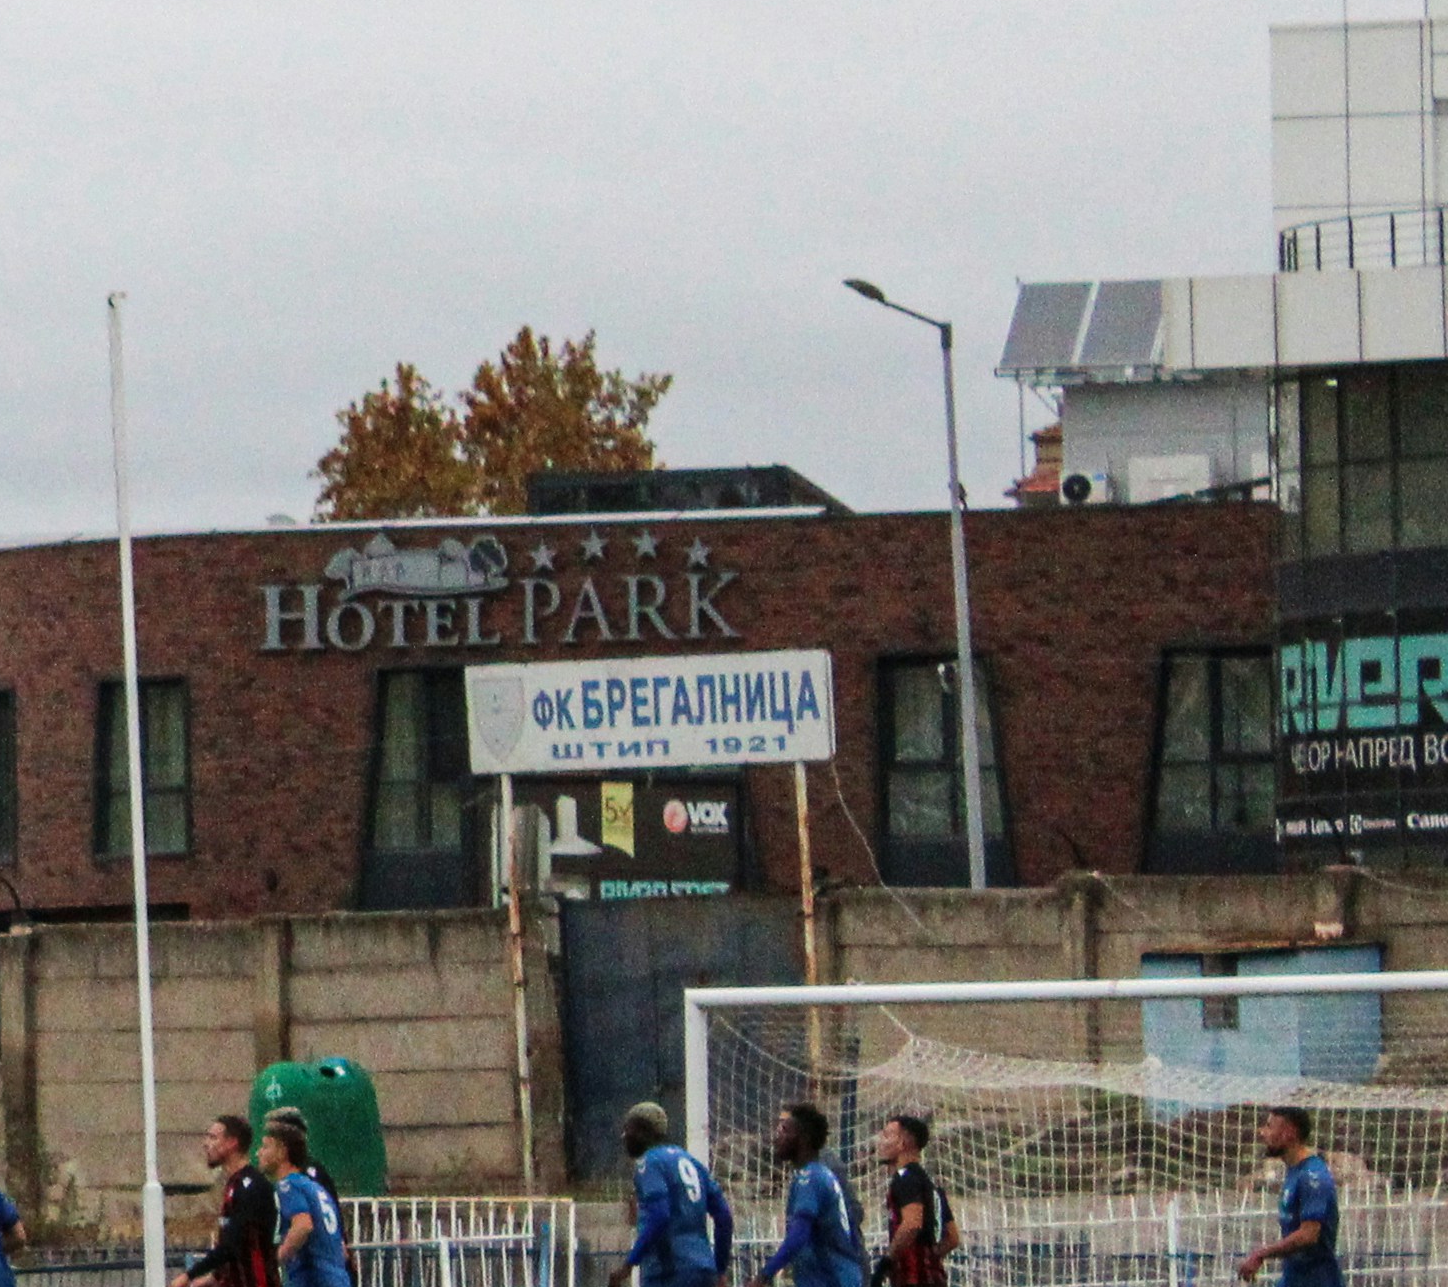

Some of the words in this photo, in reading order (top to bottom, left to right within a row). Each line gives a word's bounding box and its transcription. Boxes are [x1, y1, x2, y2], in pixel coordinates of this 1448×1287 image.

[259, 583, 502, 651] HOTEL
[519, 571, 743, 645] PARK
[532, 688, 576, 731] ФК
[581, 670, 822, 735] БРЕГАЛНИЦА
[552, 739, 670, 760] ШТИП
[705, 734, 788, 755] 1921
[686, 800, 728, 826] VOX
[678, 1156, 702, 1203] 9
